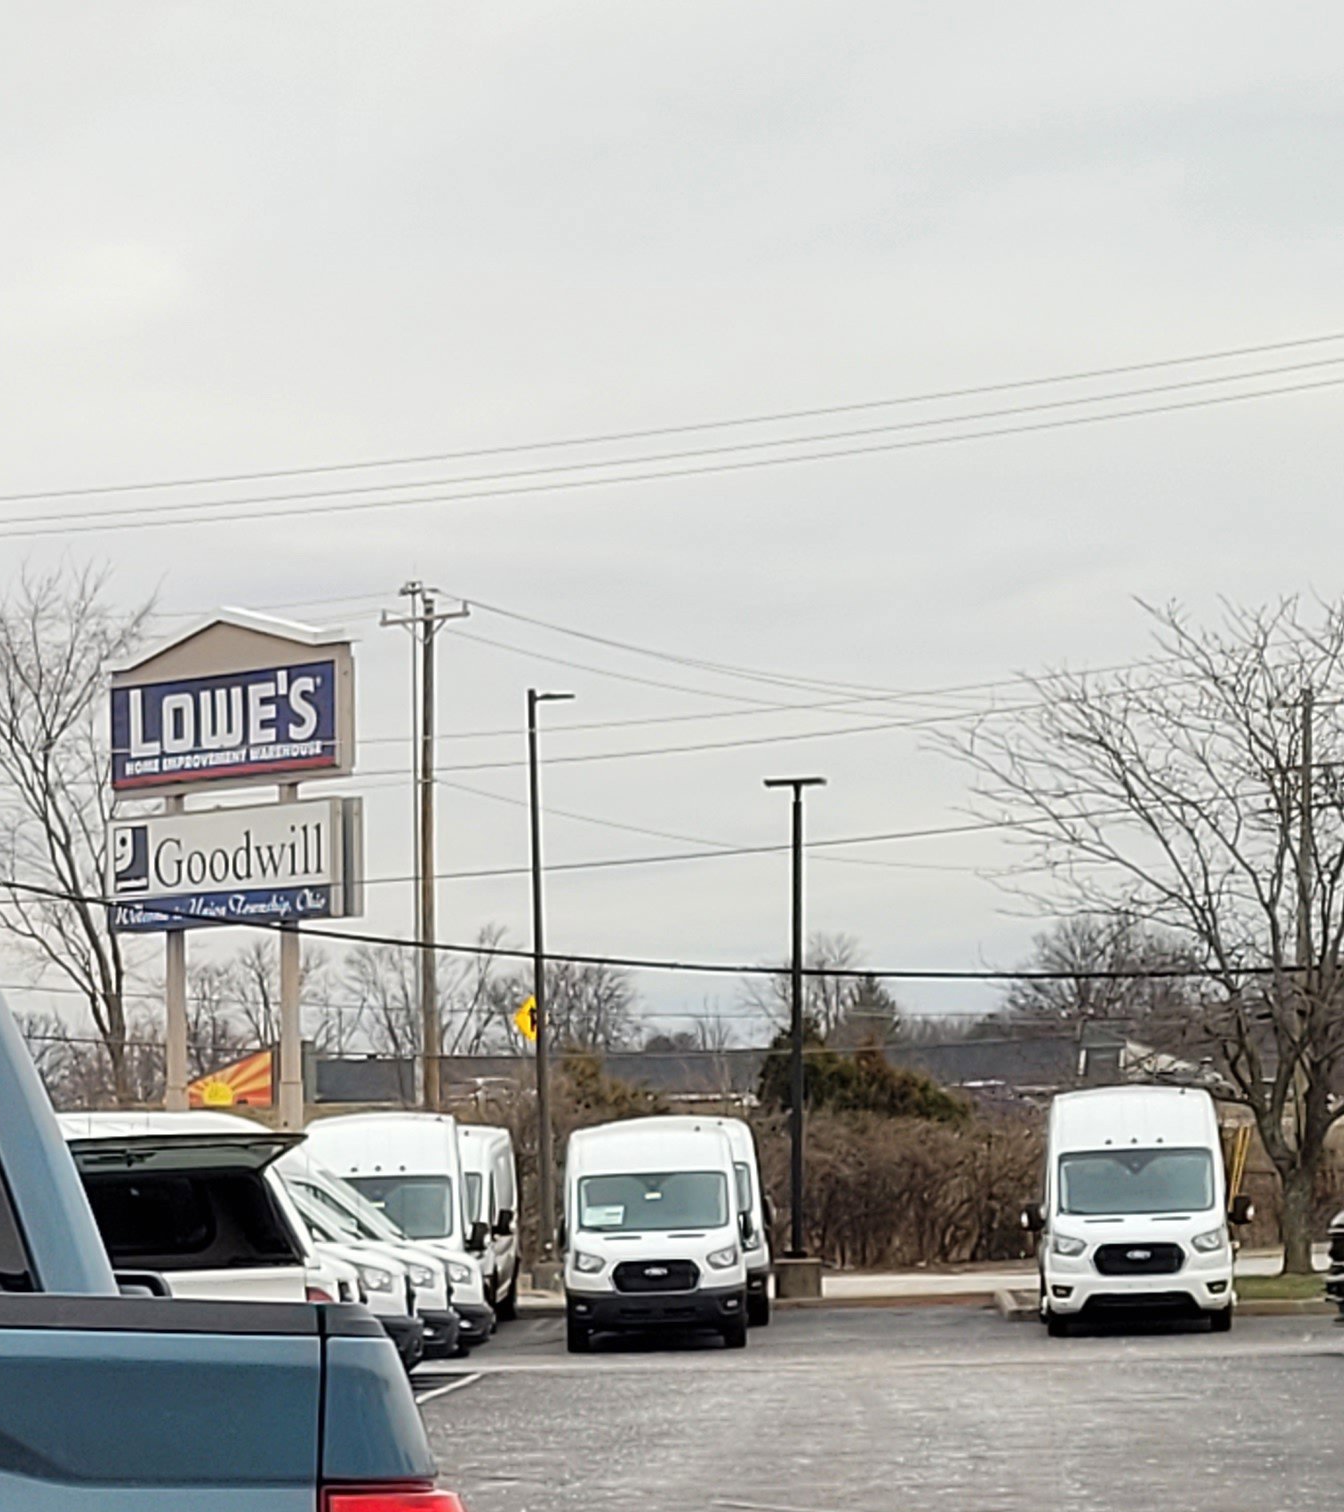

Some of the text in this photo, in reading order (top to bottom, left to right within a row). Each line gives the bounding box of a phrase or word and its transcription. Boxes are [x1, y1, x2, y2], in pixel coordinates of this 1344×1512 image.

[128, 670, 318, 758] LOWE'S
[125, 740, 323, 777] HOME IMPROVEMENT WAREHOUSE
[154, 822, 324, 888] Goodwill
